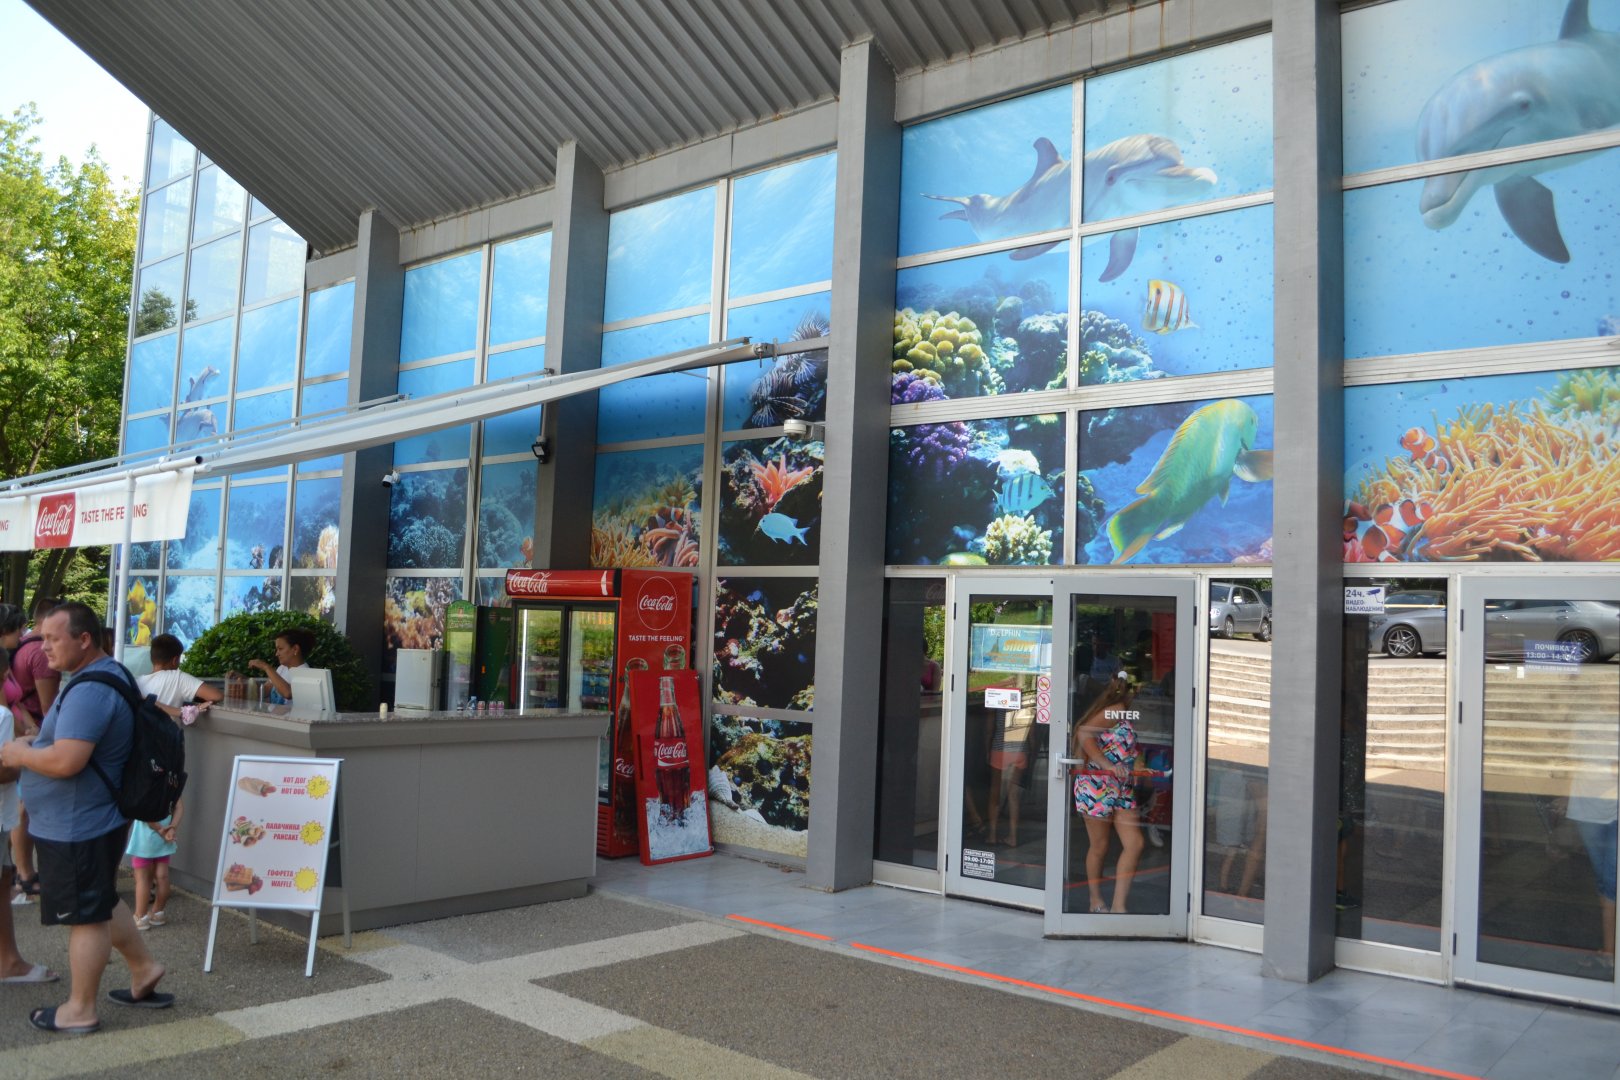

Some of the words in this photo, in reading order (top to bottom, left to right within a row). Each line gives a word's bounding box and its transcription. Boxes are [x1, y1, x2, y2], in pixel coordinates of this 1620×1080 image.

[81, 510, 100, 524] TASTE
[101, 507, 115, 521] THE
[115, 503, 148, 520] FEING
[37, 503, 73, 537] Coca-Cola
[509, 571, 552, 593] Coca-Cola
[639, 594, 675, 611] Coca-Cola
[628, 634, 646, 642] TASTE
[647, 634, 659, 642] THE
[1534, 643, 1570, 652] ПОЧИВКА
[1104, 710, 1140, 720] ENTER
[273, 833, 299, 841] PANCAKE
[271, 880, 292, 888] WAFFLE
